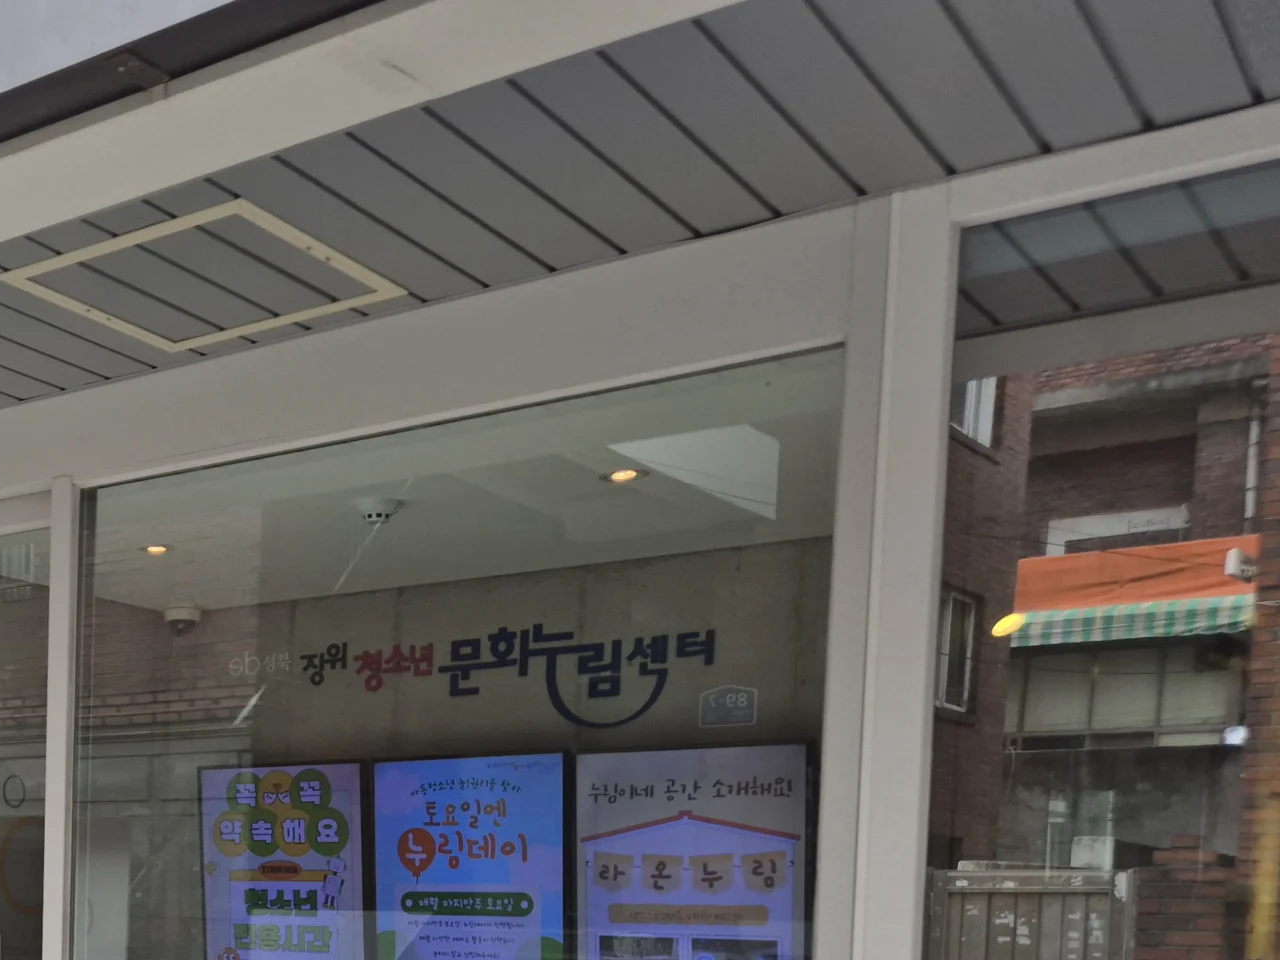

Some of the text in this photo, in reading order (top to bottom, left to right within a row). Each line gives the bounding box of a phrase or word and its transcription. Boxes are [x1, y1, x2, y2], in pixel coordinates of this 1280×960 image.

[300, 642, 348, 686] 장위
[354, 642, 434, 692] 청소년
[438, 623, 716, 729] 문화누림센터
[235, 781, 322, 807] 꼭 꼭
[587, 776, 793, 804] 누림이네 공간 소개해요!
[423, 798, 507, 829] 토요일엔
[219, 818, 341, 845] 약속해요
[405, 830, 528, 870] 누림데이
[243, 887, 318, 917] 청소년
[418, 896, 514, 912] 매월 마지막주 토요일
